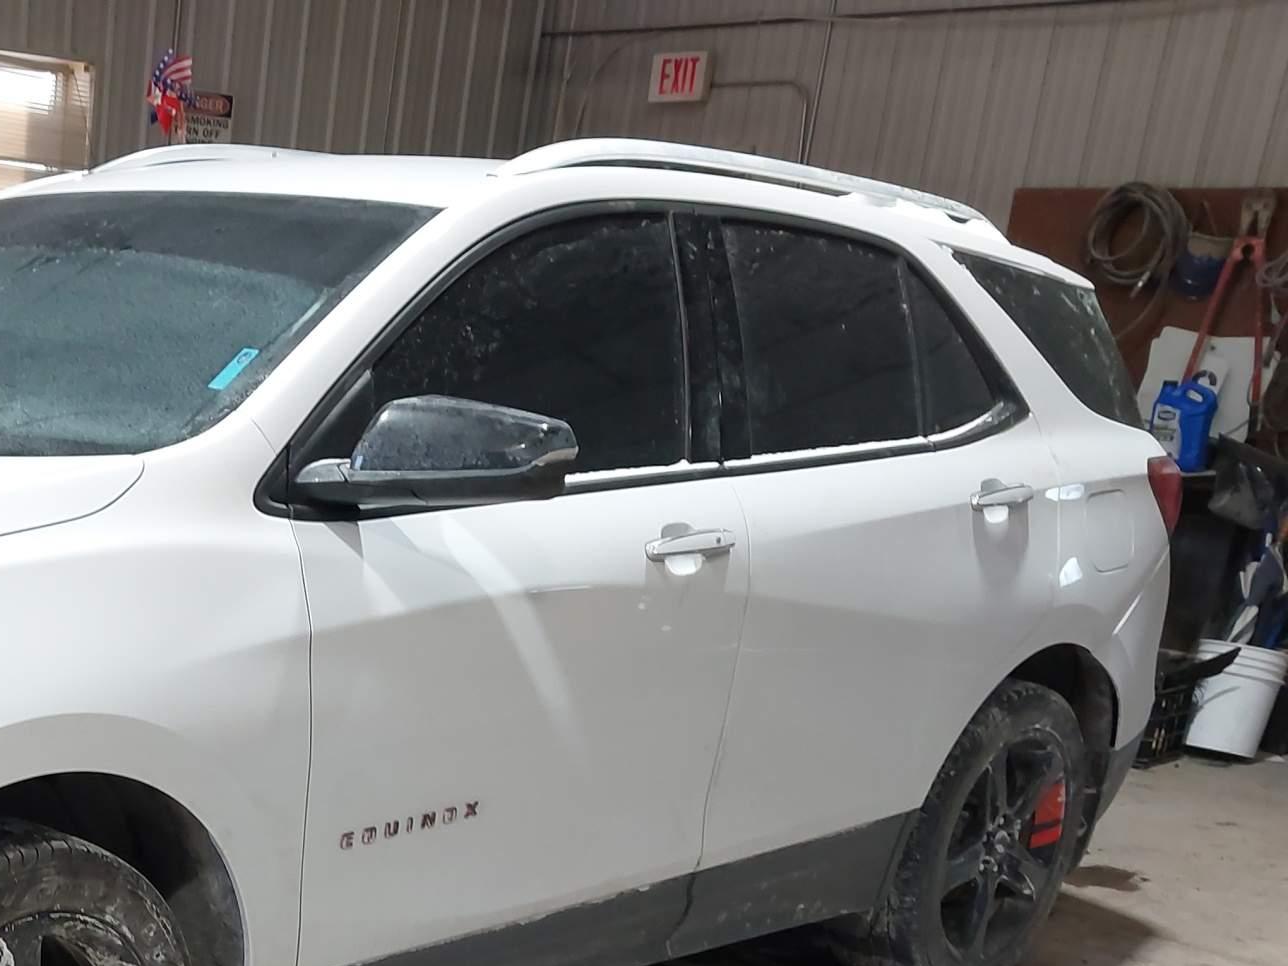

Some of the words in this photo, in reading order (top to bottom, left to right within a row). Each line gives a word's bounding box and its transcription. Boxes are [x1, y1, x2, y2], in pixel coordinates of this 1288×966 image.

[658, 56, 700, 96] EXIT
[173, 125, 199, 137] TRN
[202, 127, 220, 139] OFF
[339, 801, 479, 850] EQUINOX
